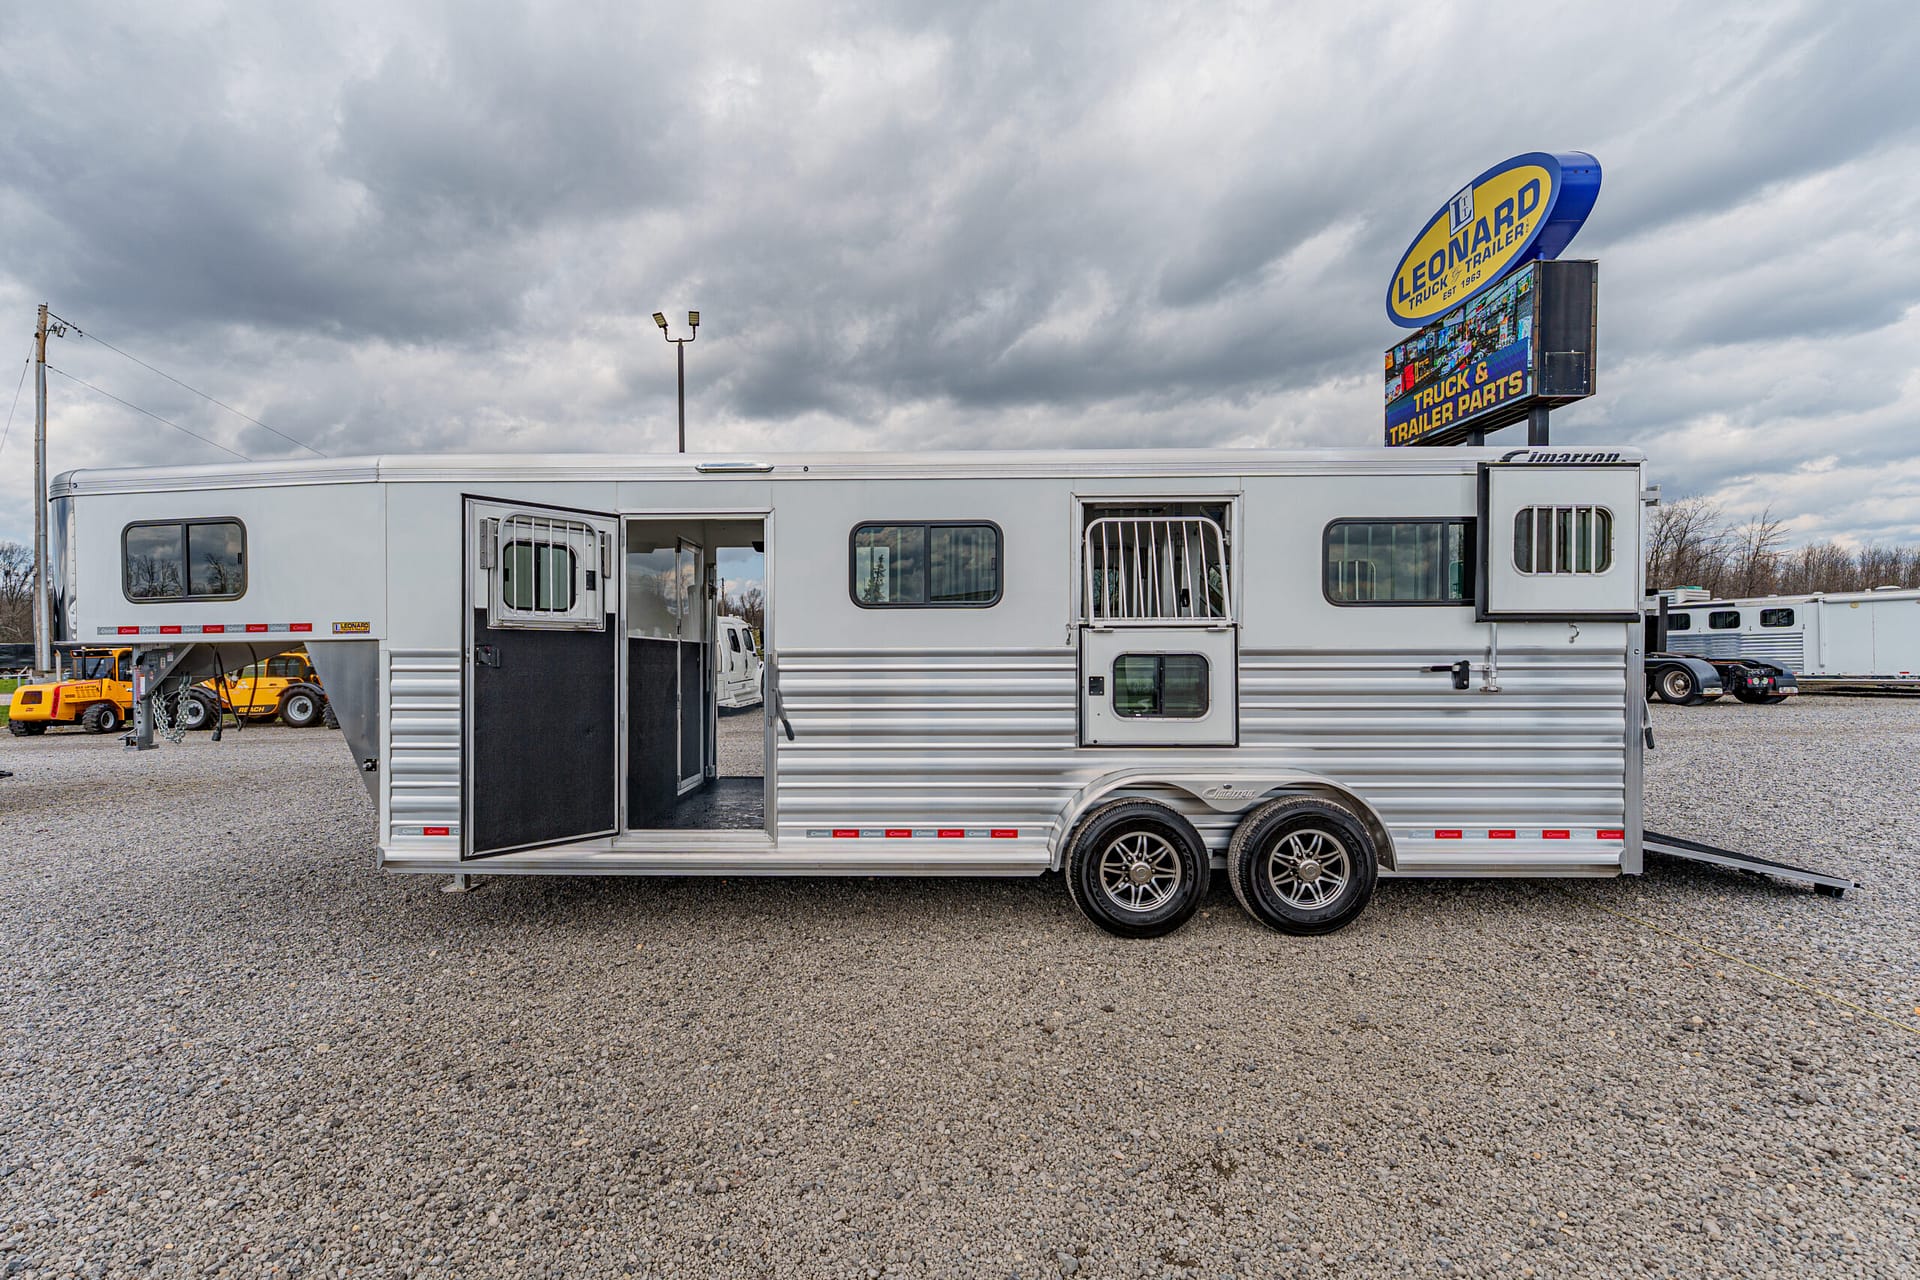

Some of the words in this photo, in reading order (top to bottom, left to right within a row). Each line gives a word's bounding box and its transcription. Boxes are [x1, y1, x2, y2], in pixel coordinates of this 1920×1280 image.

[1398, 177, 1541, 304] LEONARD
[1408, 274, 1448, 311] TRUCK
[1465, 222, 1524, 273] TRAILER
[1442, 285, 1457, 300] EST
[1461, 270, 1481, 289] 1963
[1389, 401, 1453, 446] TRAILER
[1458, 370, 1523, 417] PARTS
[1413, 367, 1470, 413] TRUCK
[1475, 361, 1488, 384] &
[1499, 450, 1621, 463] Cimarron
